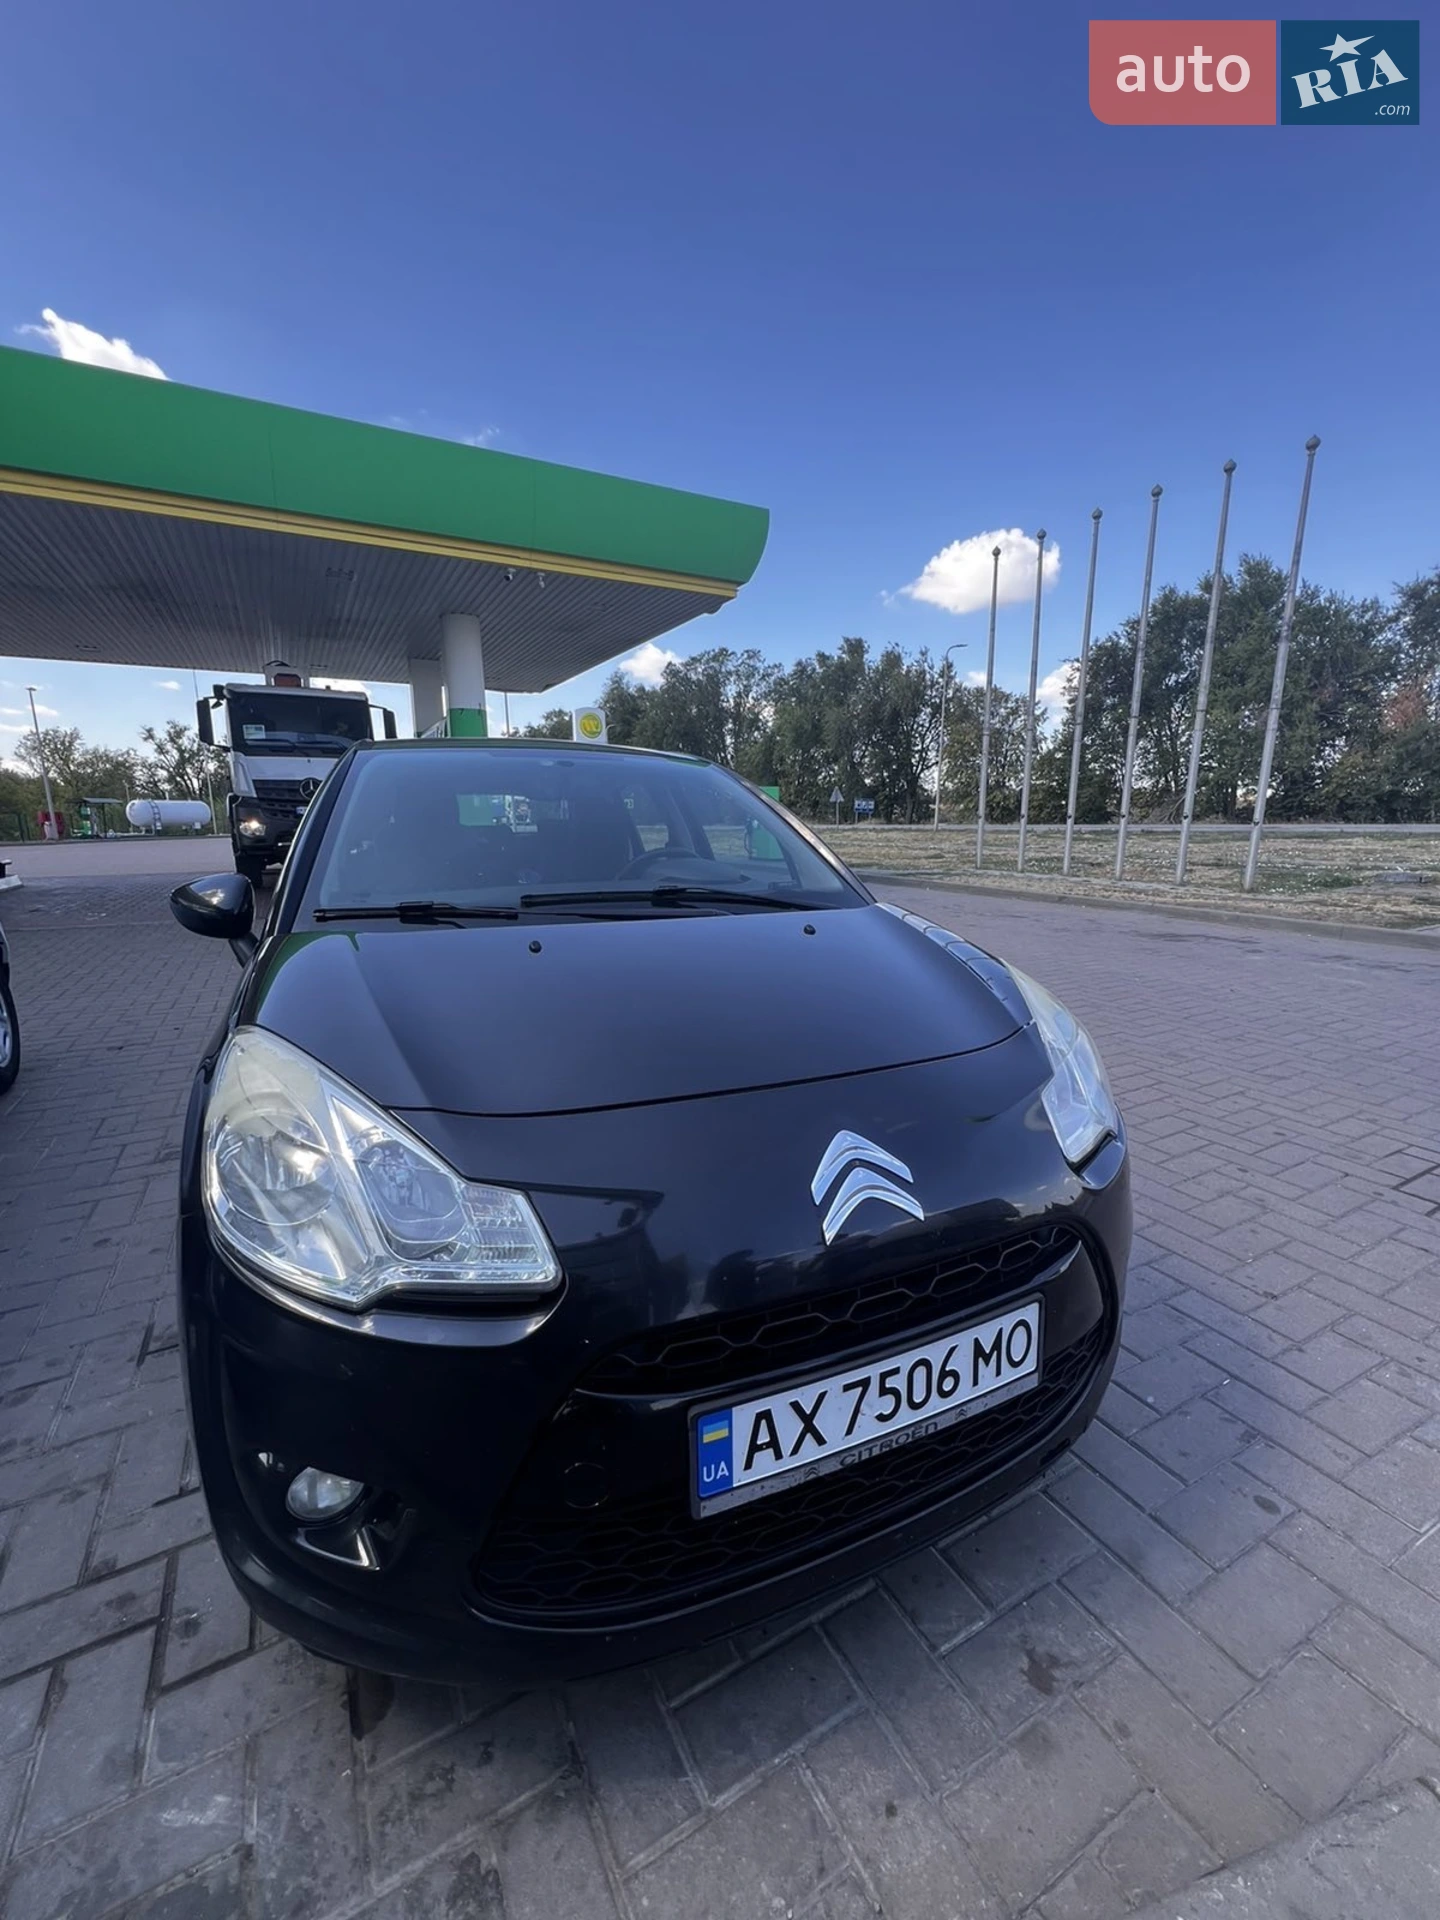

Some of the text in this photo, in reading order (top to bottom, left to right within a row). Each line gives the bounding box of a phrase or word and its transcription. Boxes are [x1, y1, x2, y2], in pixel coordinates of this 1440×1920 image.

[742, 1318, 1033, 1471] AX 7506 MO
[703, 1462, 730, 1483] UA
